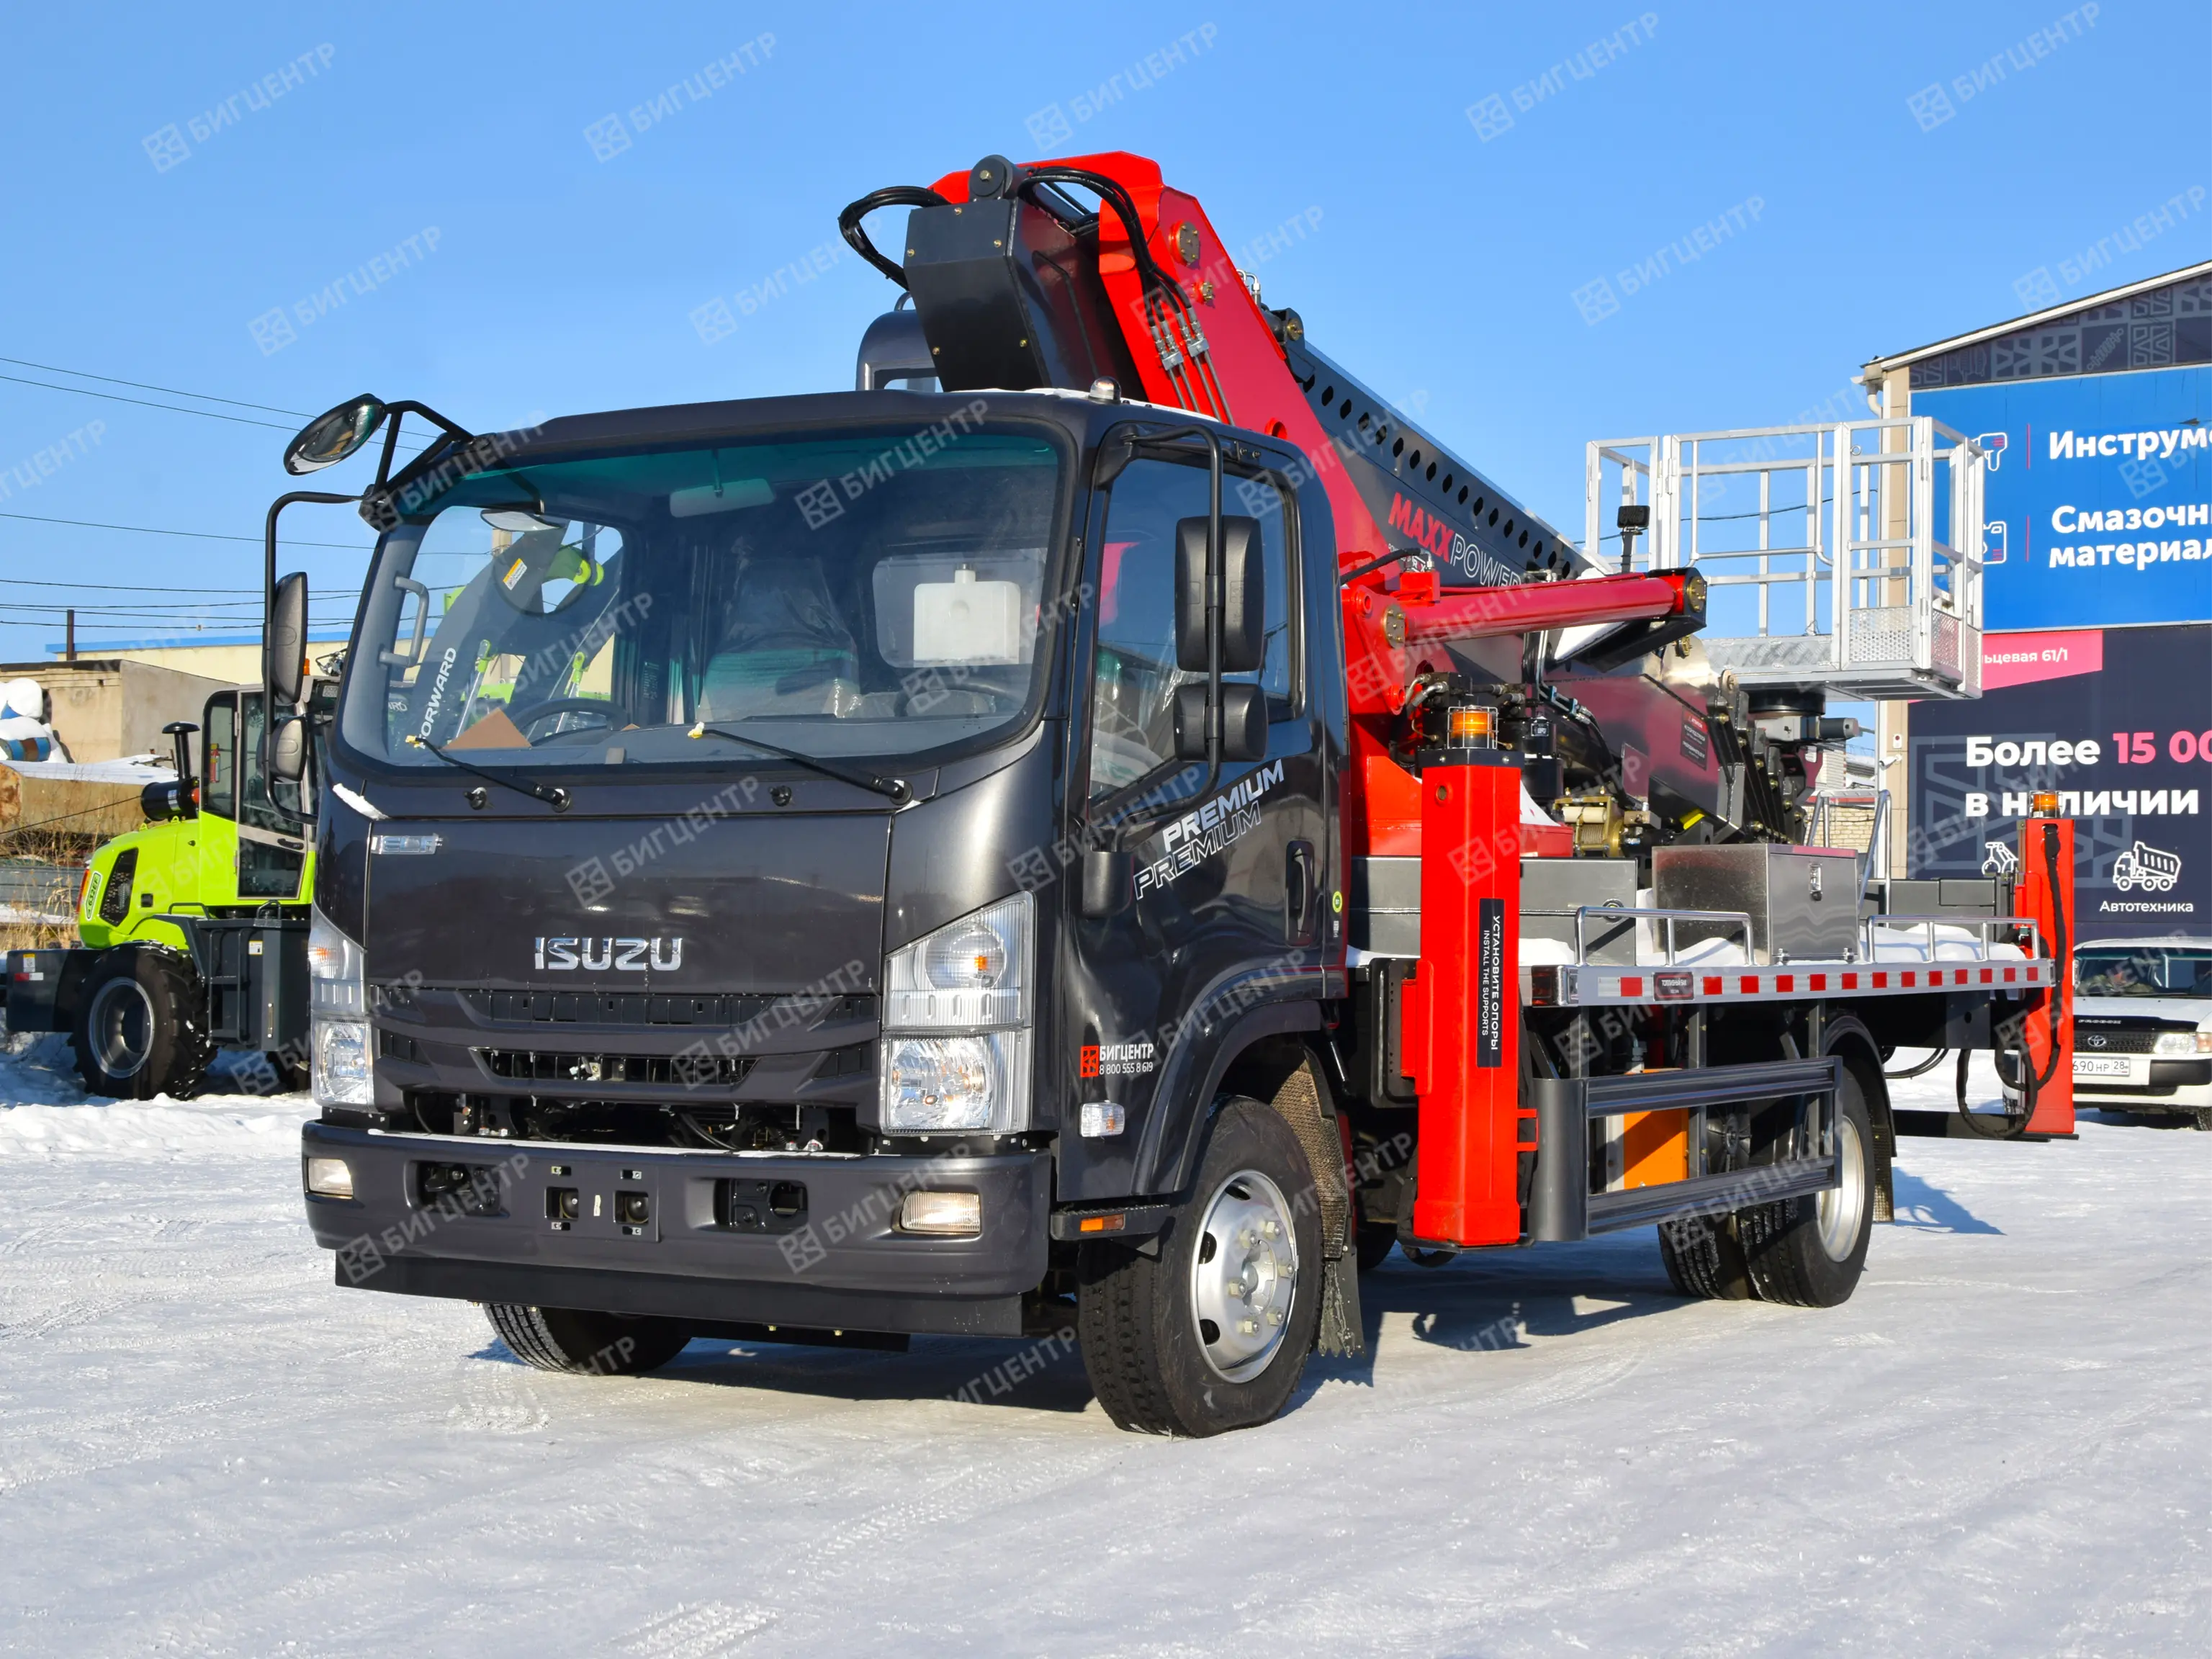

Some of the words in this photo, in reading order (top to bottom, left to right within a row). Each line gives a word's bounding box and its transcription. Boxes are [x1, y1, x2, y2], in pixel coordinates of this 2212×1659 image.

[2050, 427, 2212, 460] Инструм
[2051, 504, 2212, 534] Смазочн
[1982, 652, 2038, 665] ьцевая
[2042, 647, 2068, 662] 61/1
[1966, 736, 2100, 767] Более
[2113, 732, 2157, 764] 15
[1162, 759, 1285, 853] PREMIUM
[1966, 793, 1990, 817] в
[2002, 790, 2199, 817] нличии
[1133, 800, 1262, 900] PREMIUM
[2099, 900, 2194, 912] Автотехника
[535, 938, 683, 971] ISUZU
[1492, 915, 1501, 999] УСТАНОВИТЕ
[1491, 1002, 1499, 1050] ОПОРЫ
[1099, 1043, 1154, 1062] БИГЦЕНТР
[1099, 1065, 1105, 1075] 8
[1106, 1064, 1121, 1074] 800
[1122, 1062, 1135, 1074] 555
[1136, 1062, 1141, 1072] 8
[1142, 1061, 1154, 1072] 619
